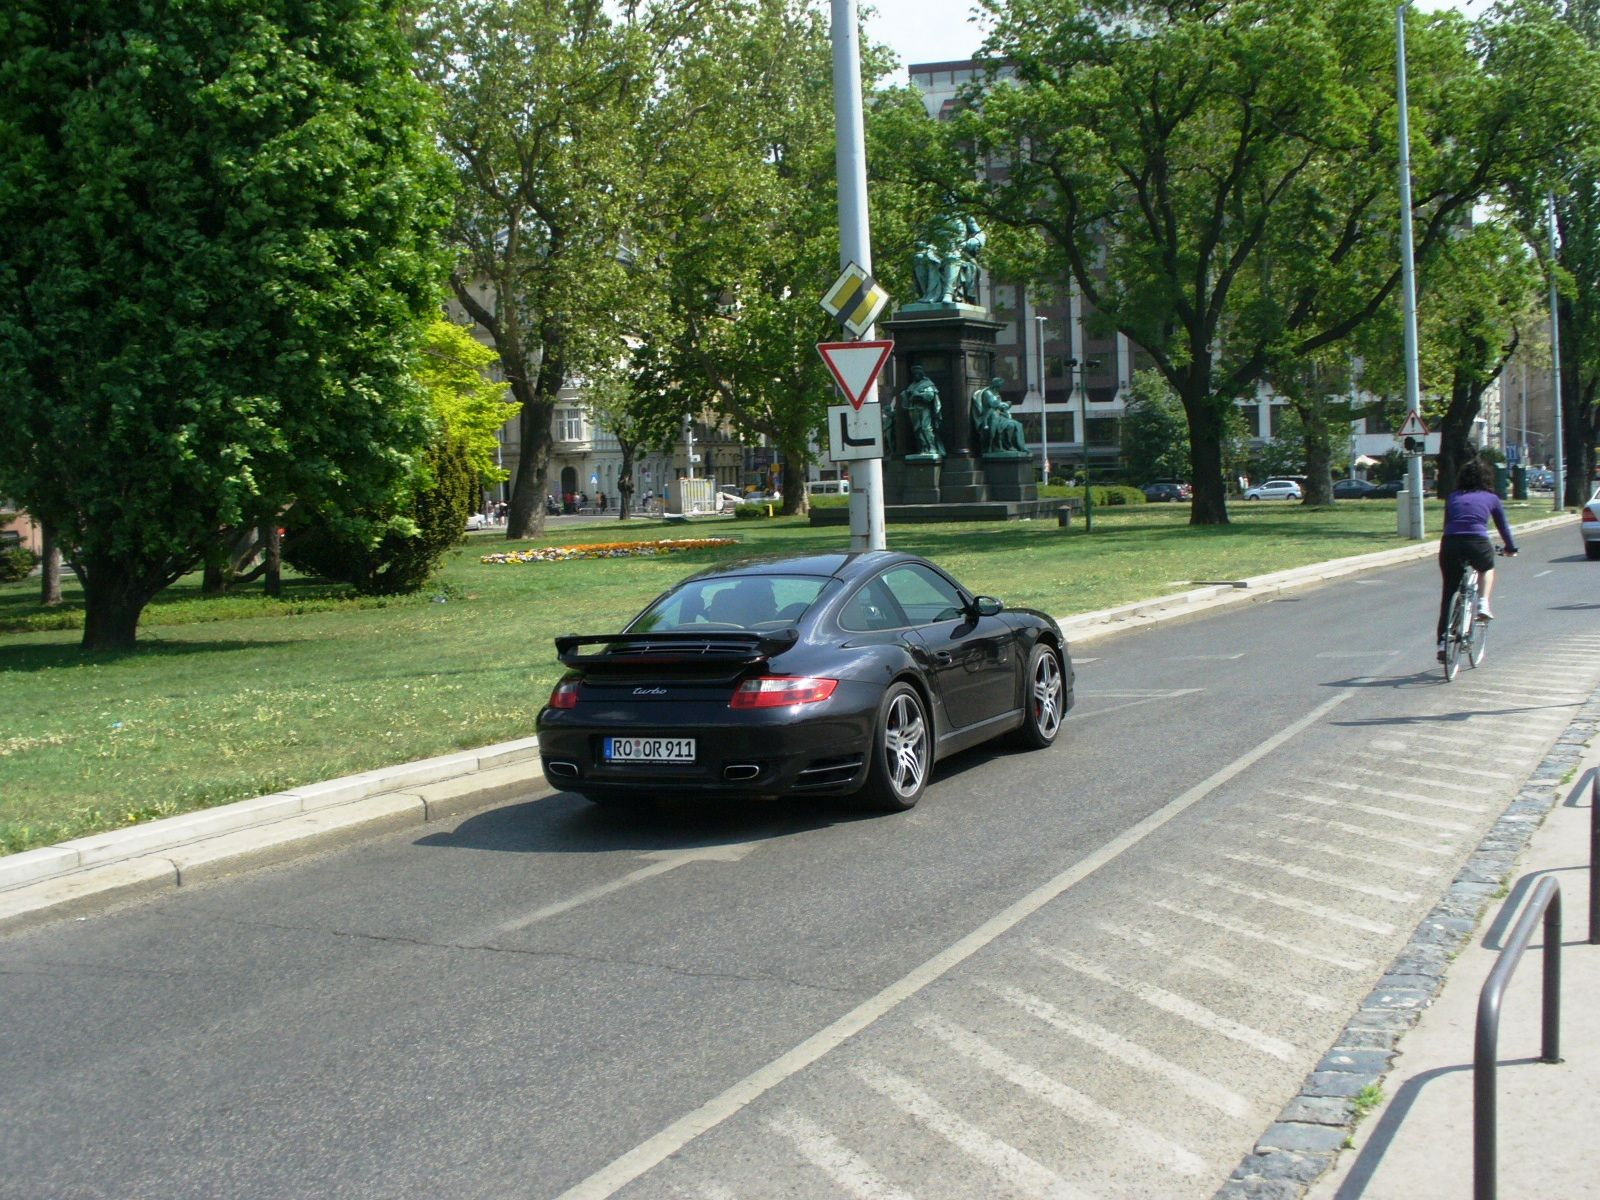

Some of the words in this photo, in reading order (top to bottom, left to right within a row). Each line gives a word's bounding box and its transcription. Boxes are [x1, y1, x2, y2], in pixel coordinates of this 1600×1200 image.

[613, 740, 632, 756] RO
[643, 741, 662, 757] OR
[665, 741, 693, 757] 911
